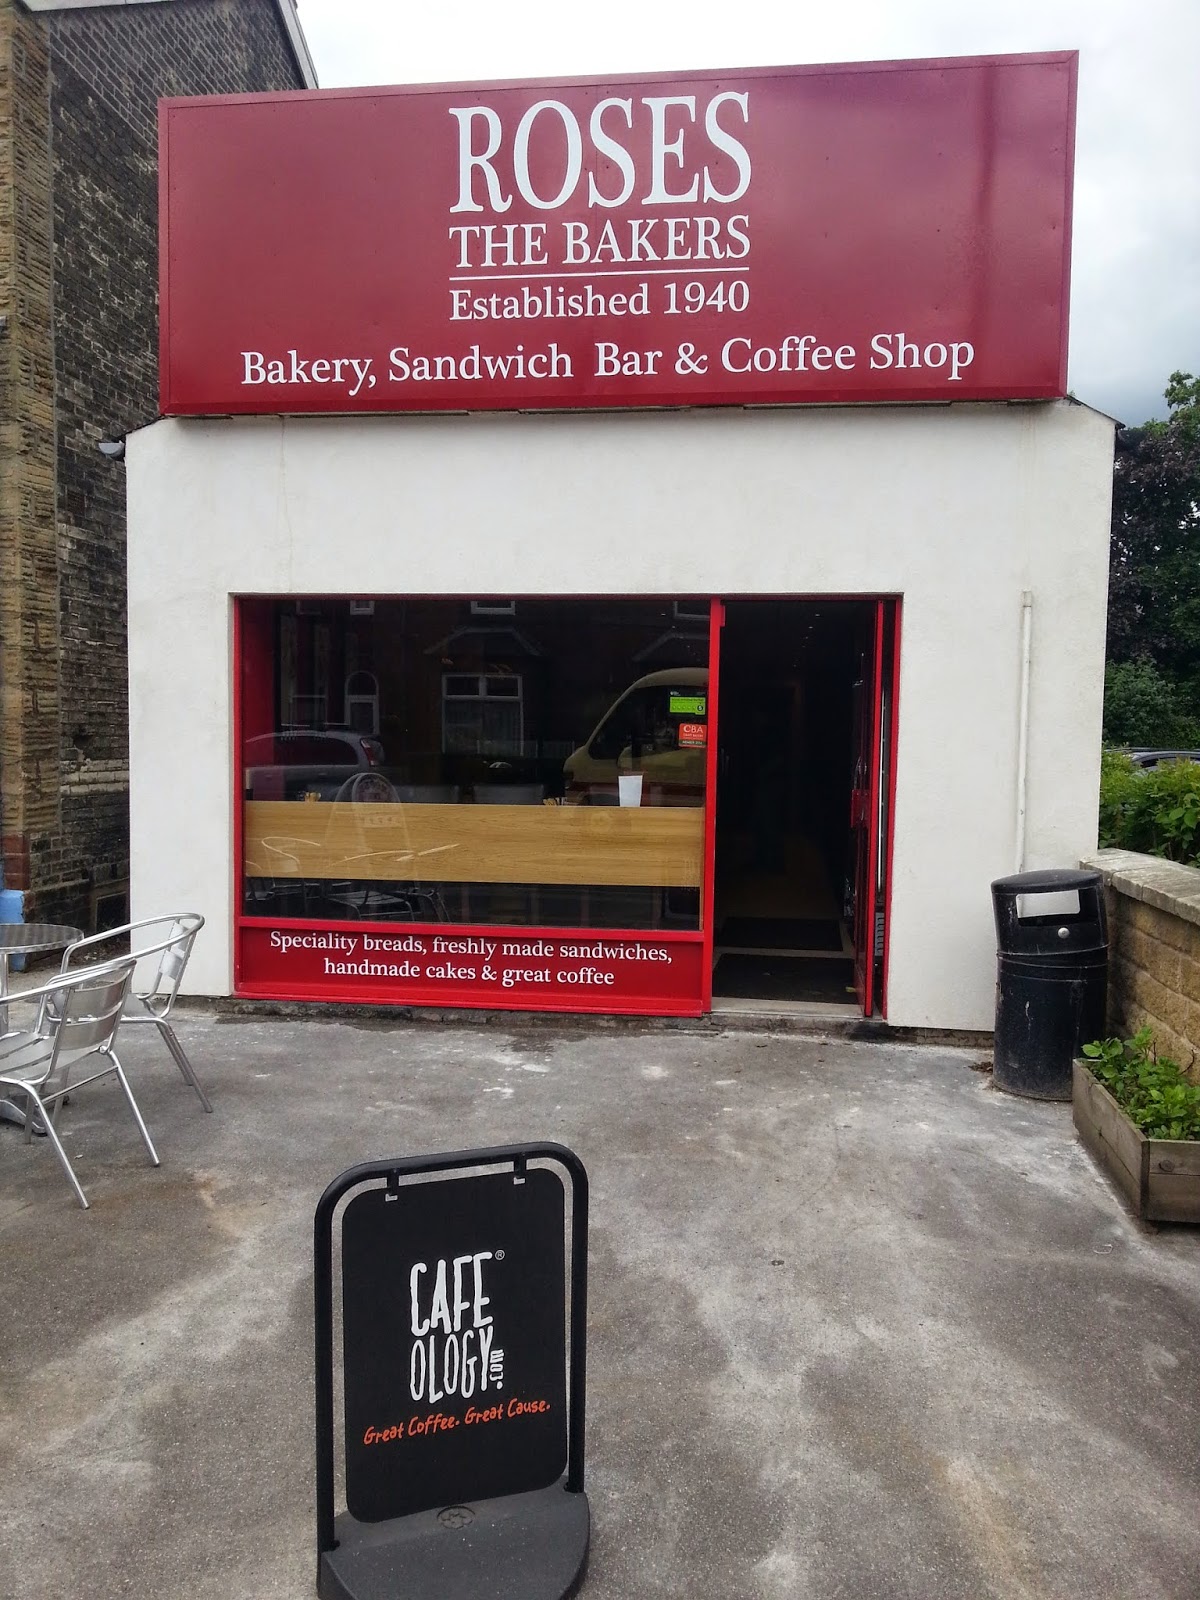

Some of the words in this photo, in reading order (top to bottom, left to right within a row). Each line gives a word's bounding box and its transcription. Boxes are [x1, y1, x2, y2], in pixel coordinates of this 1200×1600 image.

[449, 91, 752, 214] ROSES
[449, 224, 548, 268] THE
[562, 214, 751, 264] BAKERS
[449, 283, 651, 321] Established
[664, 280, 750, 314] 1940
[240, 349, 377, 397] Bakery,
[389, 342, 574, 382] Sandwich
[594, 342, 662, 377] Bar
[675, 342, 708, 375] &
[721, 335, 856, 373] Coffee
[870, 332, 975, 382] Shop
[683, 725, 704, 734] CBA
[270, 930, 358, 957] Speciality
[363, 934, 428, 957] breads,
[432, 936, 497, 962] freshly
[502, 940, 555, 958] made
[559, 942, 673, 965] sandwiches,
[323, 957, 421, 978] handmade
[425, 961, 476, 980] cakes
[481, 965, 498, 981] &
[501, 969, 552, 989] great
[556, 966, 615, 986] coffee
[410, 1251, 494, 1338] CAFE
[363, 1424, 404, 1446] Great
[407, 1414, 460, 1438] Coffee.
[464, 1405, 504, 1426] Great
[507, 1397, 552, 1419] Cause.
